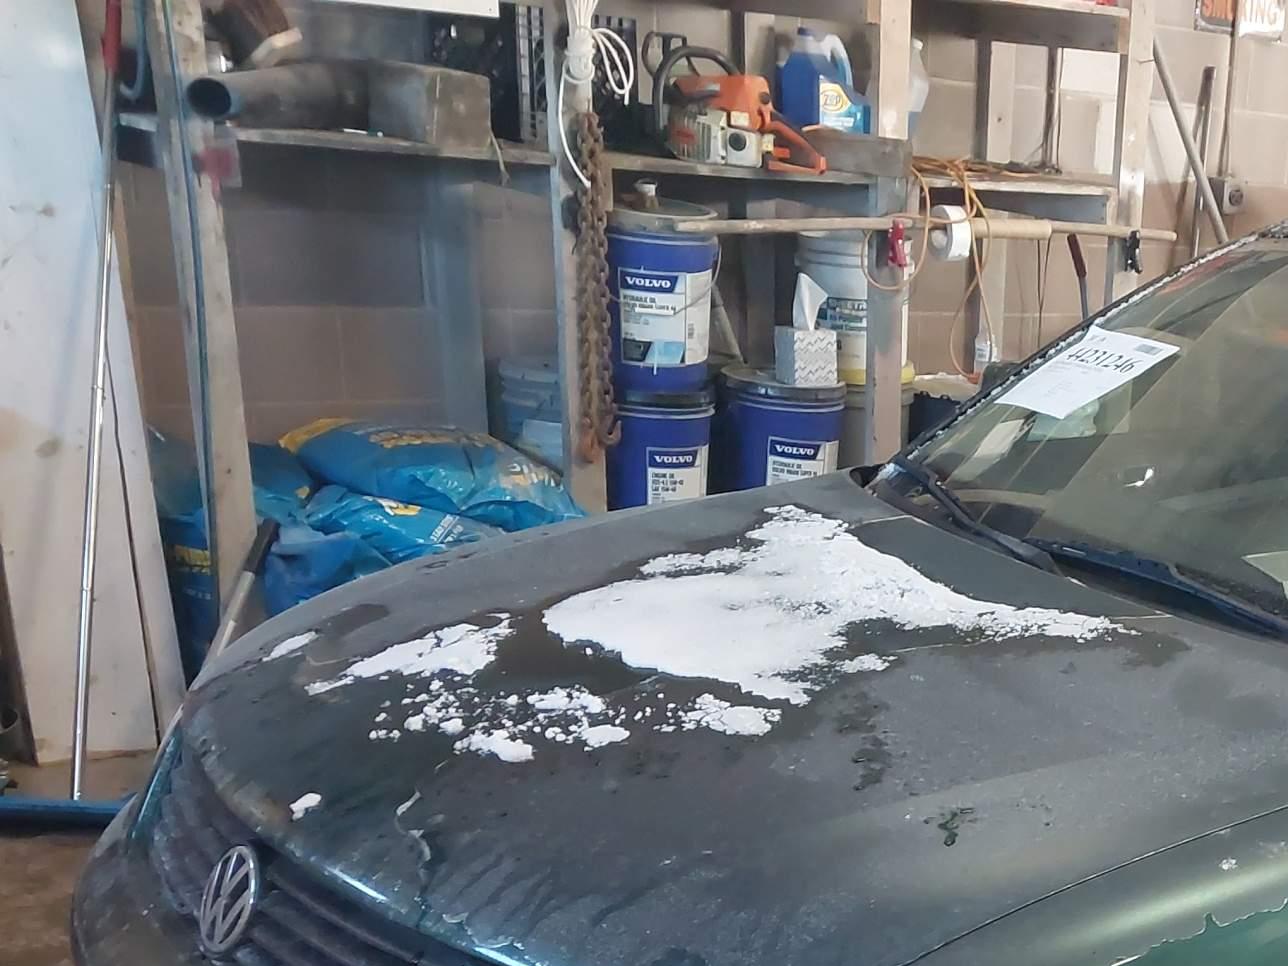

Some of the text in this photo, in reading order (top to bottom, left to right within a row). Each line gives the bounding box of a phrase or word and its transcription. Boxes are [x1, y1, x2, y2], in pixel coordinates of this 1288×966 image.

[625, 276, 671, 288] VOLVO
[774, 444, 815, 456] VOLVO
[653, 455, 693, 463] VOLVO
